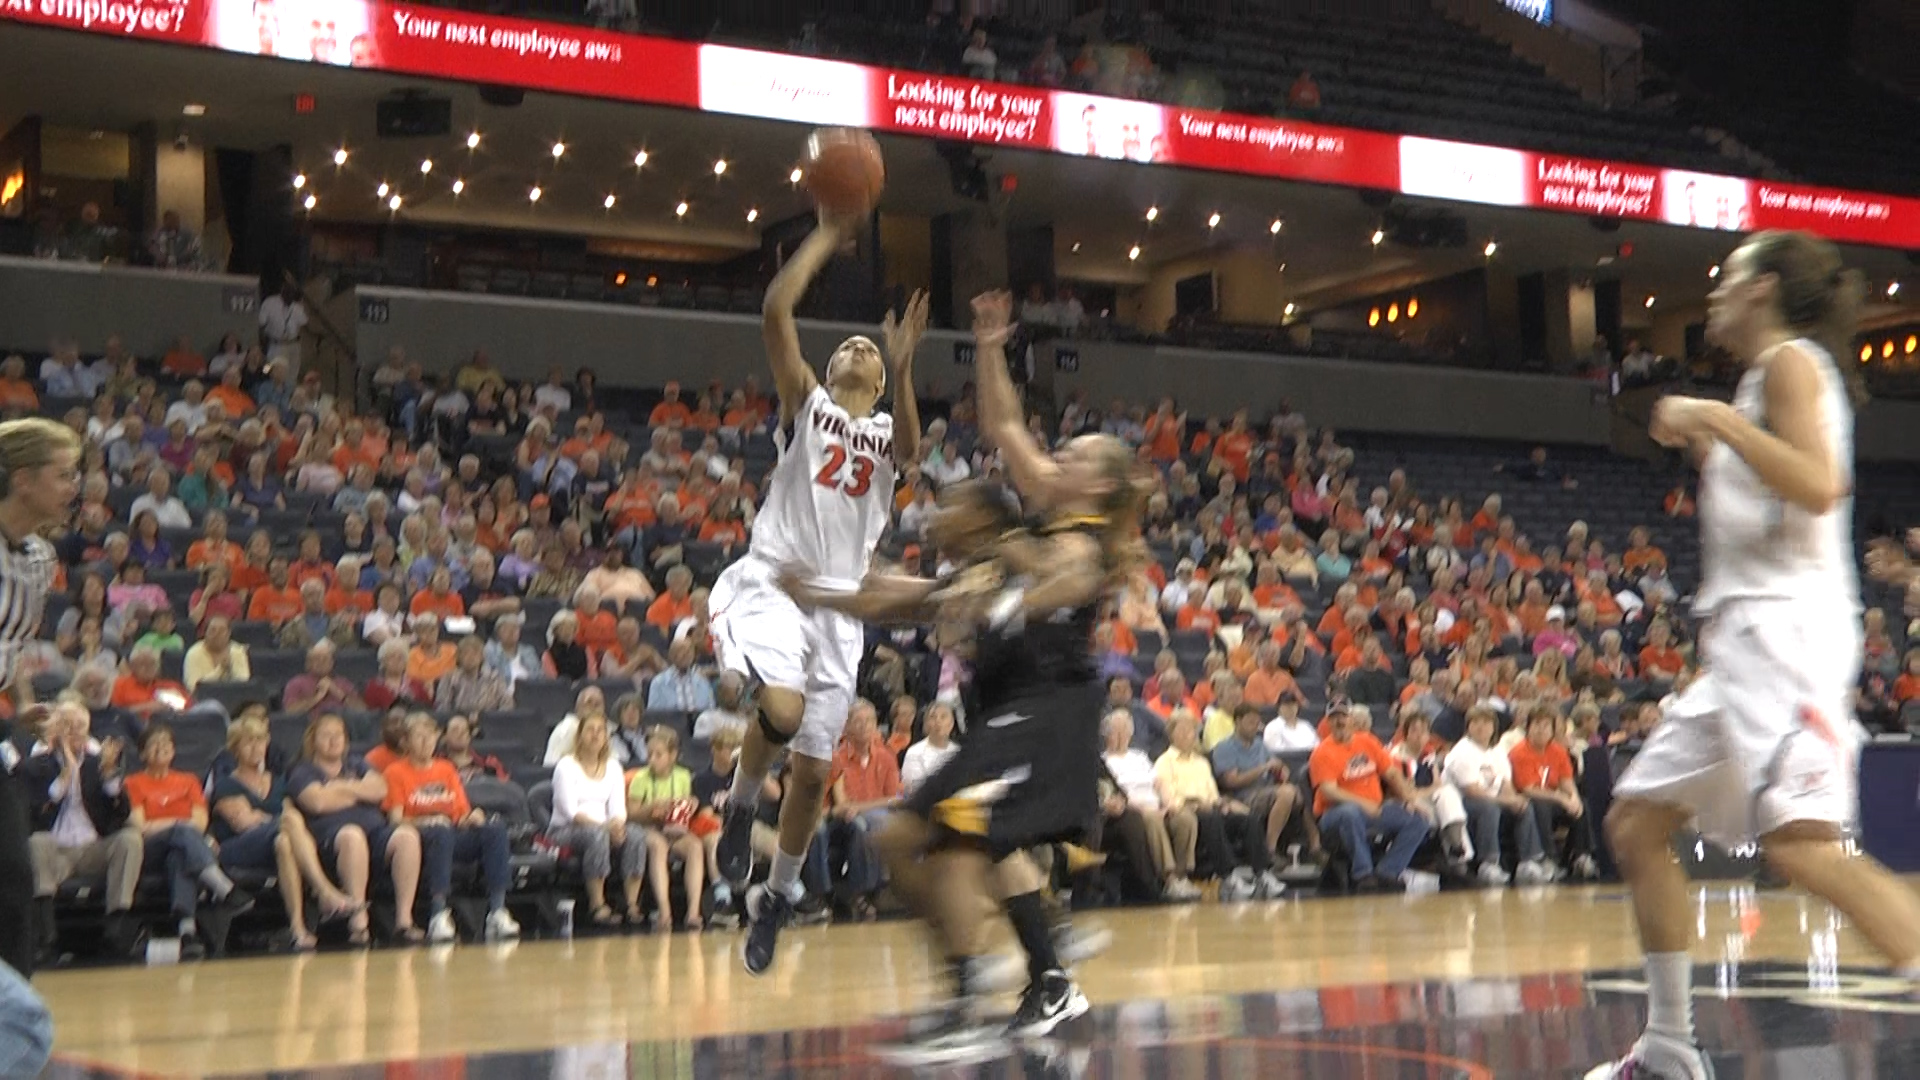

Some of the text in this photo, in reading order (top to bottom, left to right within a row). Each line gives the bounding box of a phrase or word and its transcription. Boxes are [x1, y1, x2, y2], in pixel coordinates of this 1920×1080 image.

[393, 9, 441, 39] Your
[445, 22, 486, 46] next
[490, 28, 581, 60] employee
[887, 73, 1043, 117] Looking for your
[895, 104, 1037, 142] next employee?
[1180, 113, 1214, 138] Your
[1216, 123, 1247, 142] next
[1249, 125, 1314, 154] employee
[815, 443, 874, 496] 23
